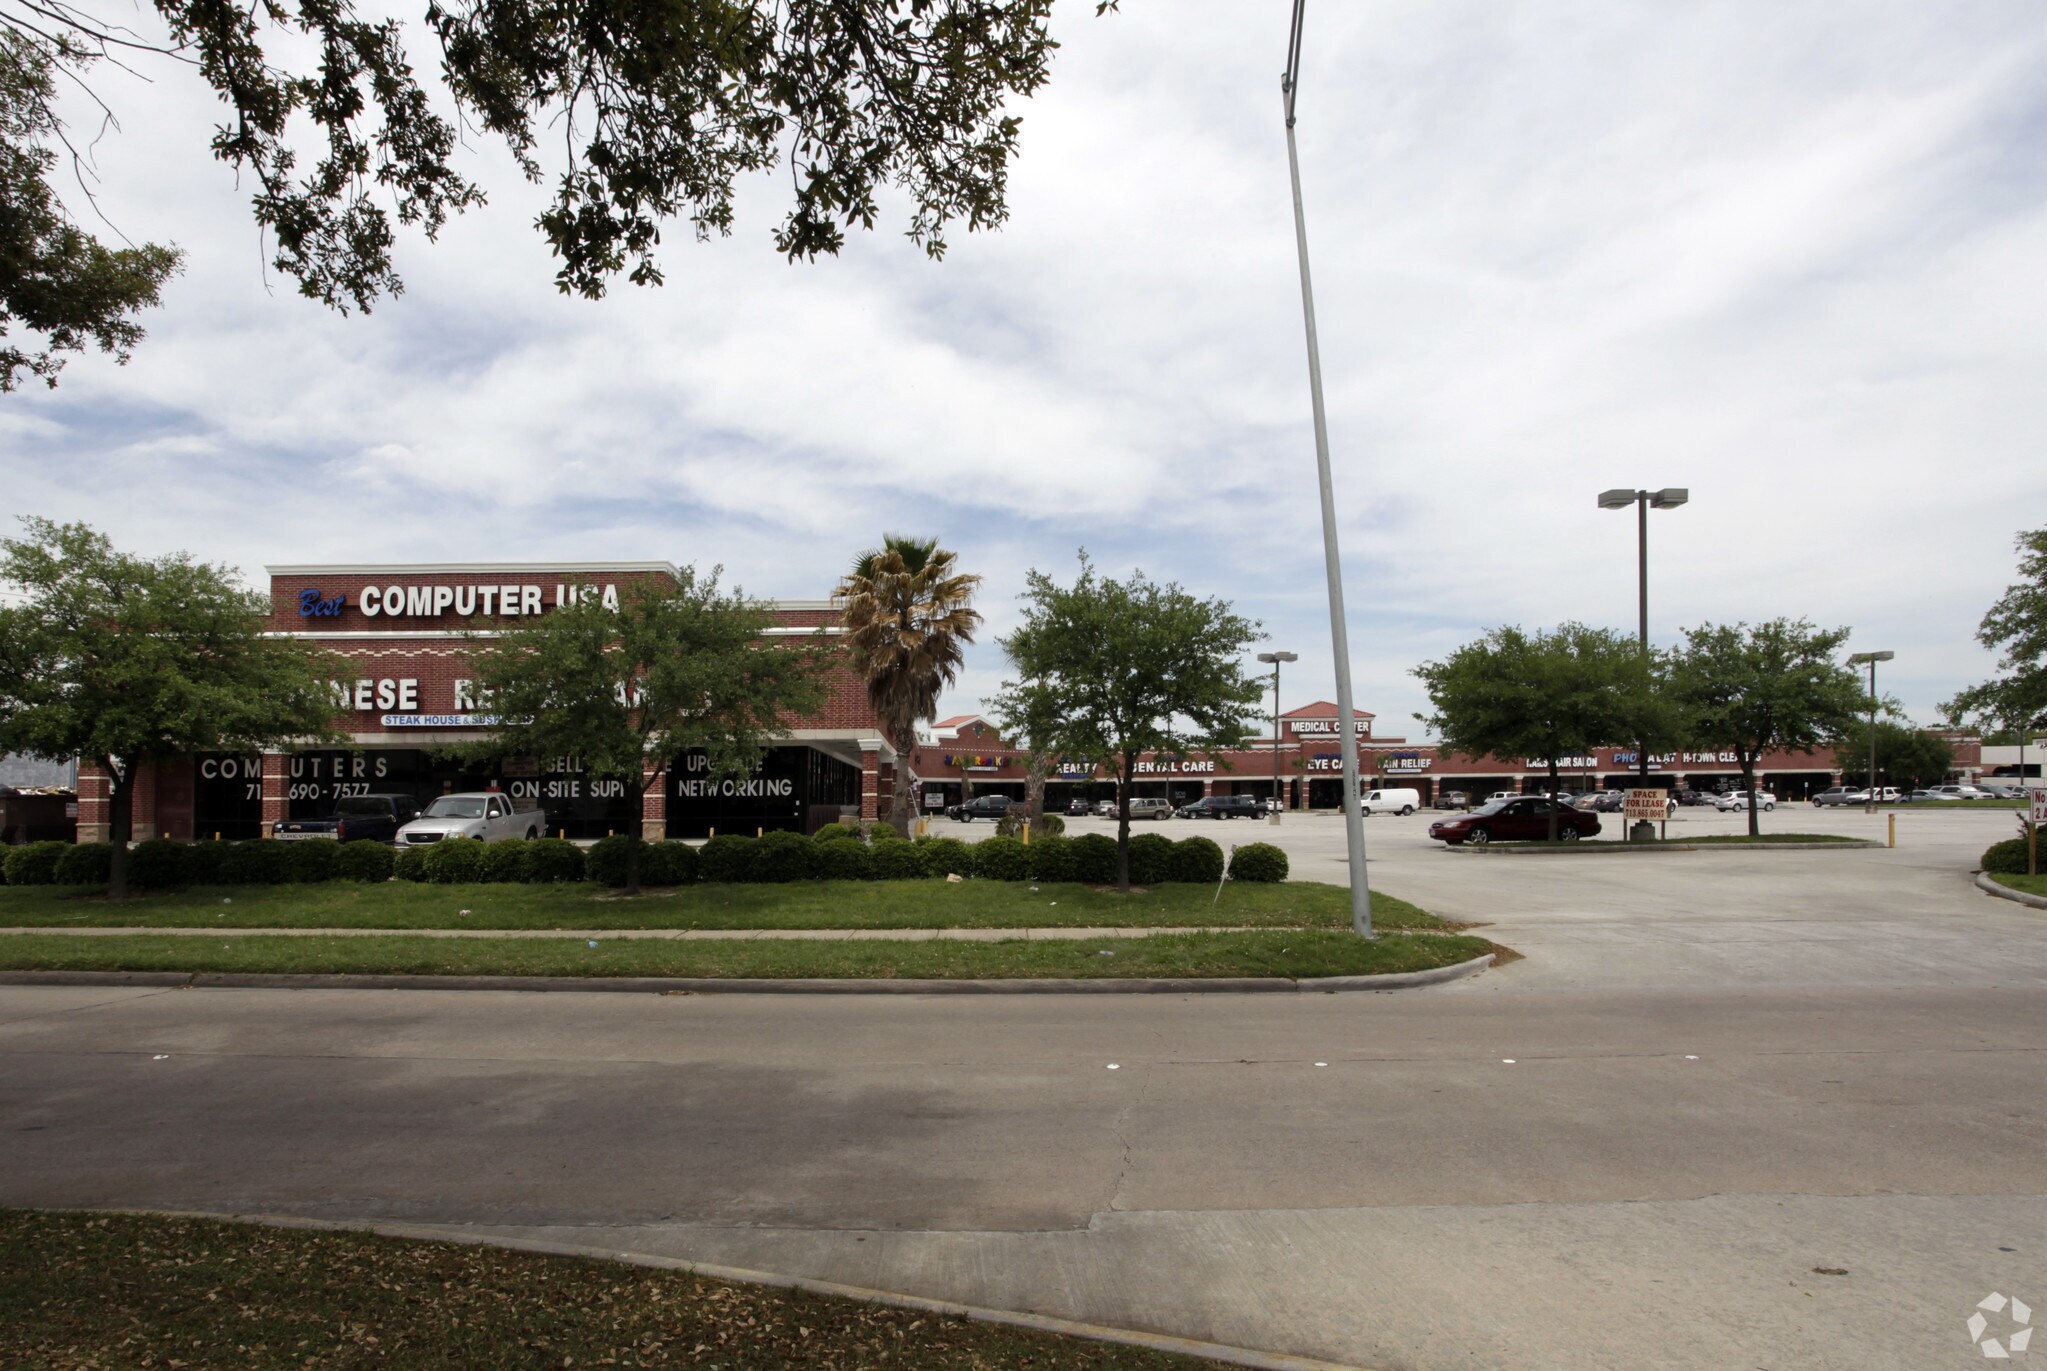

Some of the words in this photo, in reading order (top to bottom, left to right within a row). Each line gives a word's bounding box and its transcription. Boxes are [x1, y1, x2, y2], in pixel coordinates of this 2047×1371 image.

[298, 588, 345, 617] Best
[359, 584, 543, 617] COMPUTER
[556, 583, 620, 614] USA
[384, 715, 421, 725] STEAK
[424, 715, 461, 725] HOUSE
[1291, 721, 1331, 732] MEDICAL
[1334, 721, 1369, 732] CTER
[201, 757, 388, 779] COMUTERS
[1182, 761, 1214, 772] CARE
[1307, 759, 1329, 769] EYE
[1378, 759, 1398, 769] AIN
[1401, 758, 1431, 768] RELIEF
[246, 783, 262, 800] 71
[510, 780, 580, 798] ON-SITE
[679, 779, 793, 797] NETWORKING
[1632, 791, 1658, 799] SPACE
[2035, 791, 2046, 803] No
[1626, 799, 1640, 807] FOR
[1642, 799, 1664, 807] LEASE
